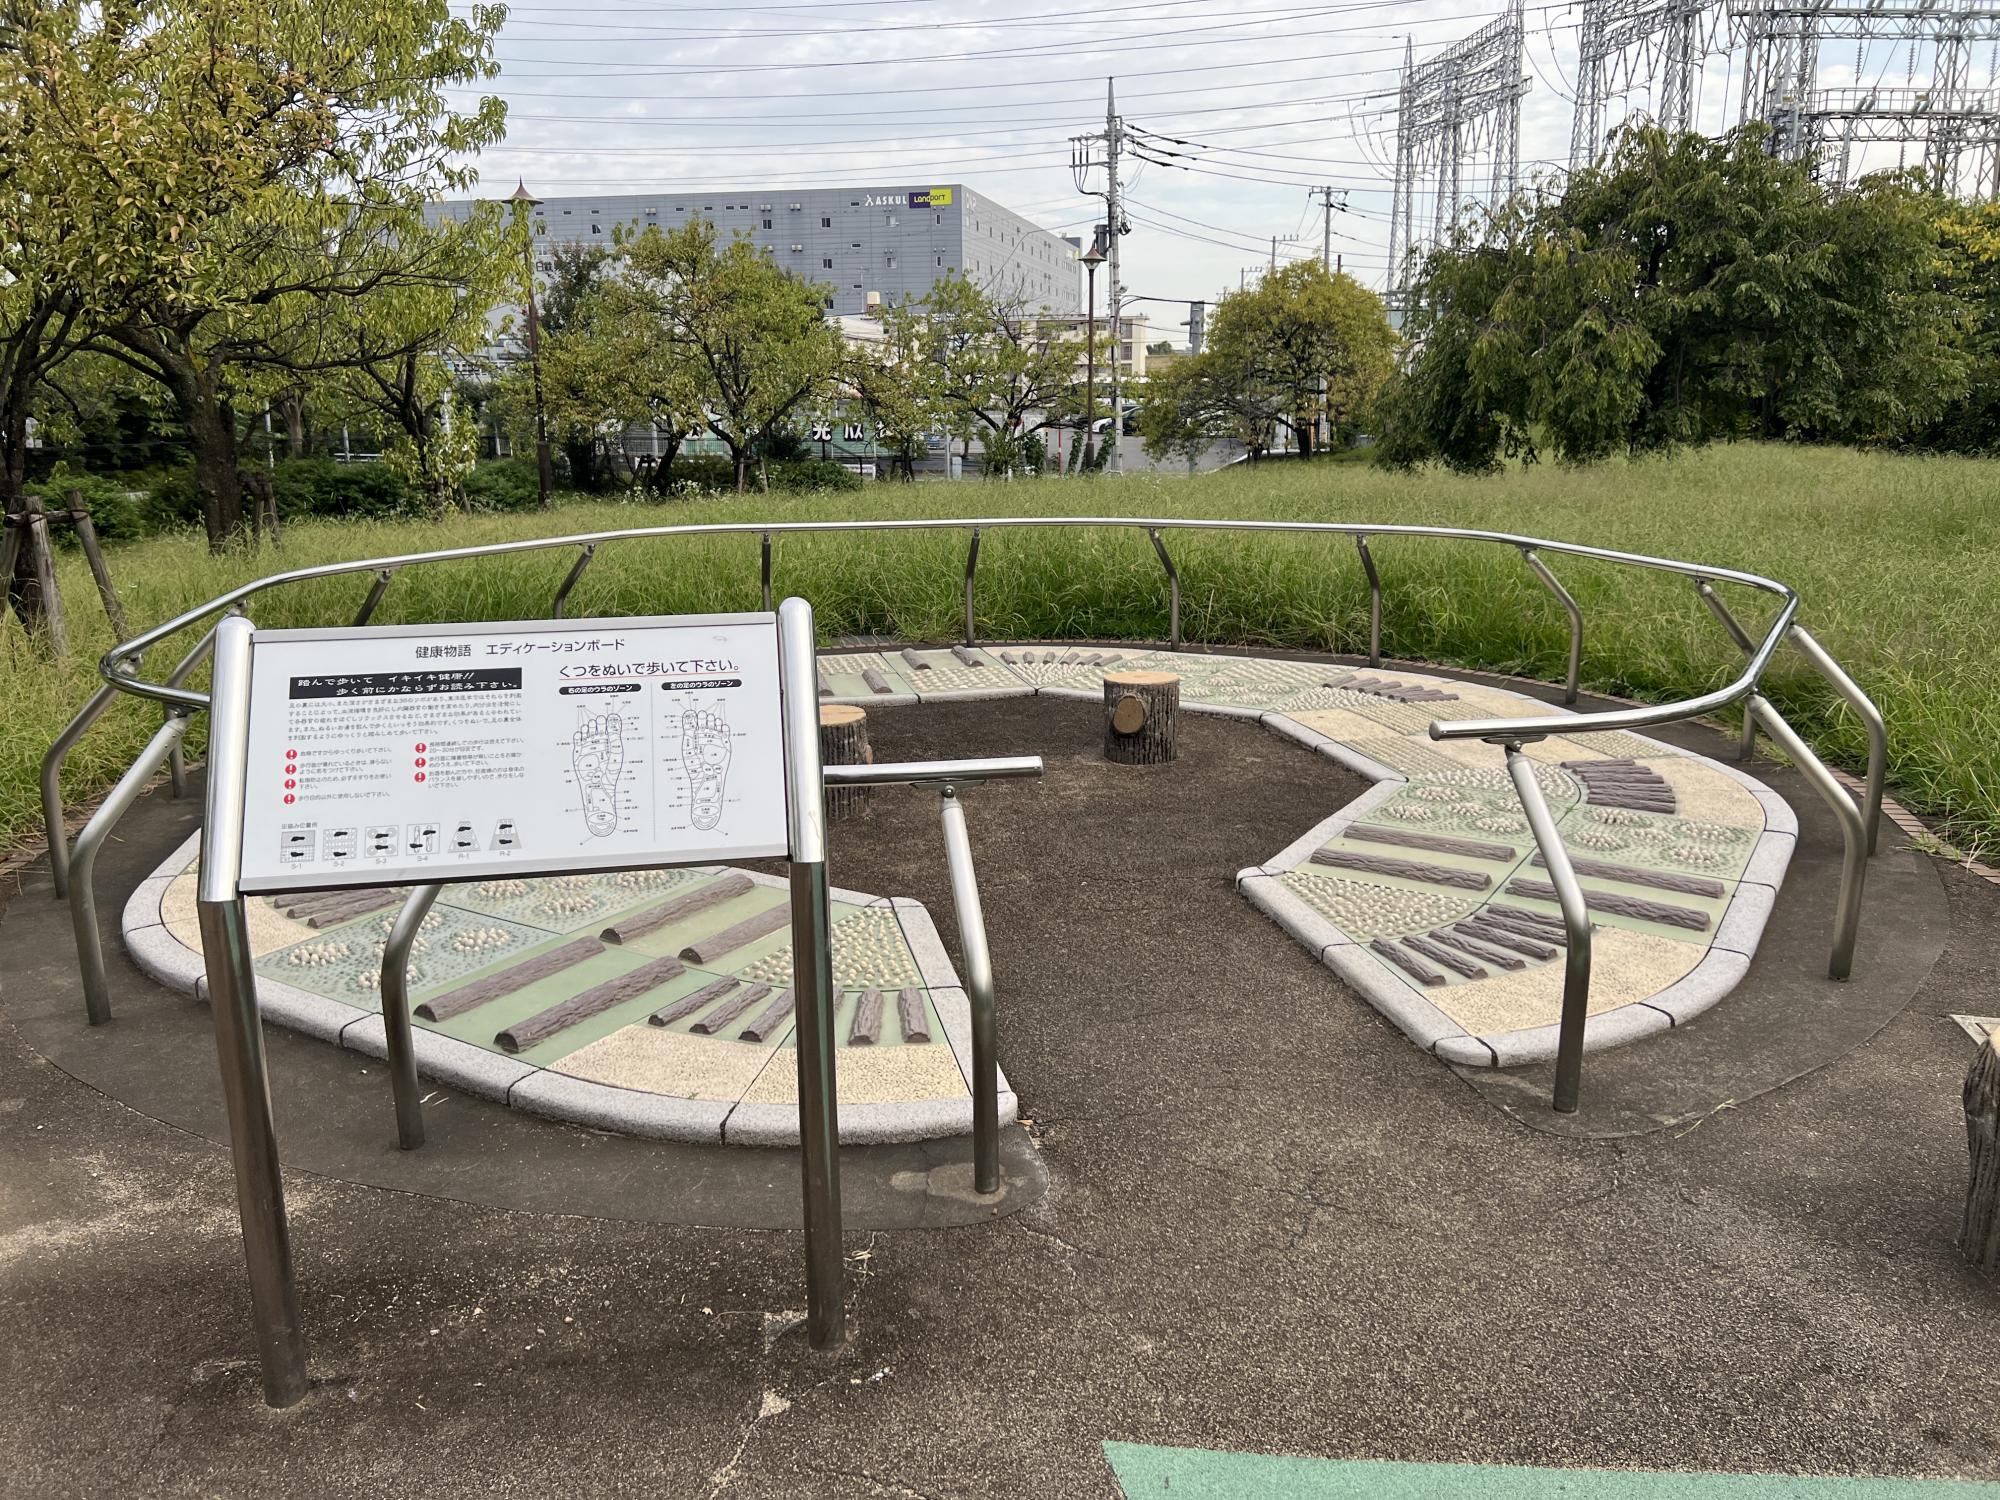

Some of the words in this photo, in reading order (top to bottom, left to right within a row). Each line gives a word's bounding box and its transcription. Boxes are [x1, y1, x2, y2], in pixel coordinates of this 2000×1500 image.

[876, 195, 907, 205] ASKUL
[416, 644, 472, 659] 健康物語
[486, 638, 625, 656] エディケーションボード
[559, 659, 739, 678] くつをぬいで歩いて下さい。
[298, 676, 374, 687] 踏んで歩いて
[336, 681, 518, 696] 歩く前にかならずお読み下さい。
[568, 684, 633, 694] 右の足のウラのゾーン
